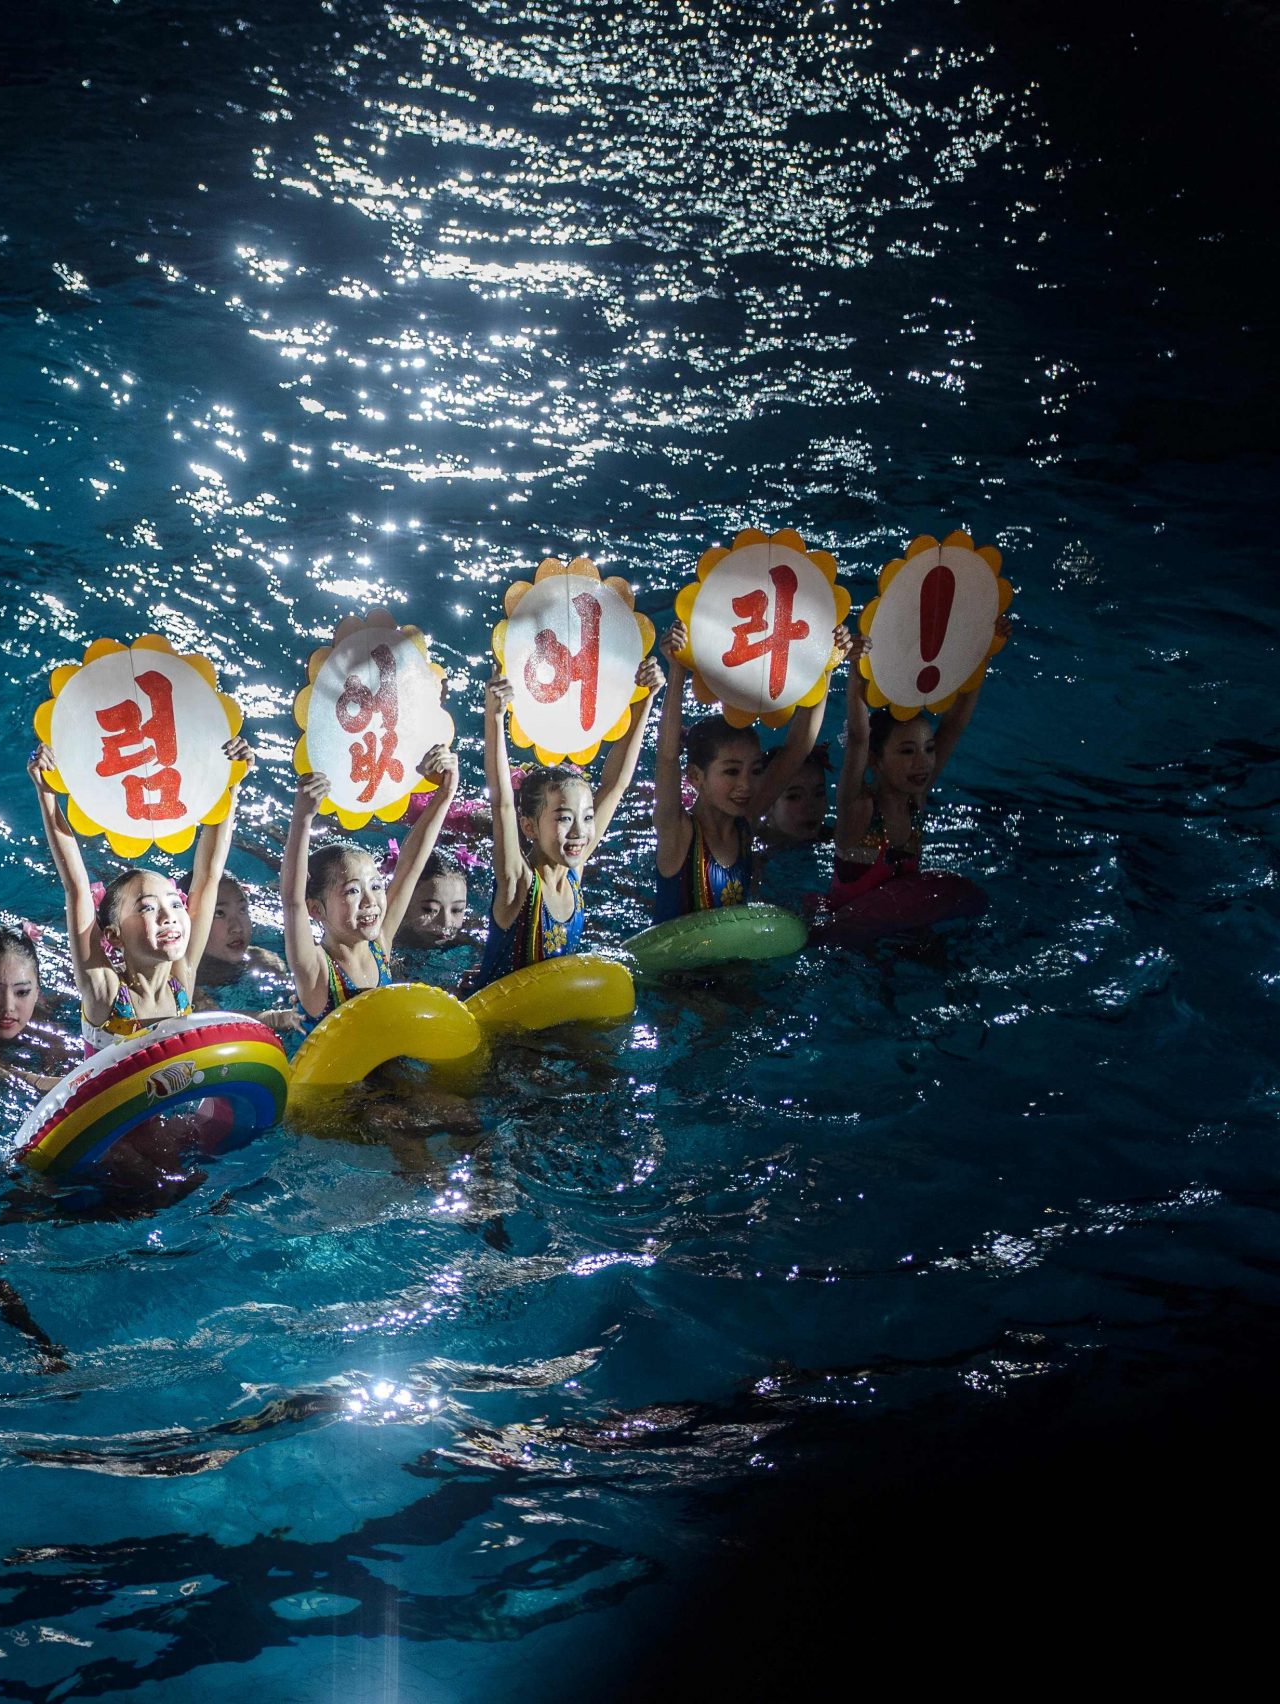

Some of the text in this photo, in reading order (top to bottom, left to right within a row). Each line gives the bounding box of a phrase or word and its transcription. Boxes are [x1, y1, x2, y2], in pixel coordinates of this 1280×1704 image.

[95, 670, 187, 821] 럼
[523, 592, 602, 732] 어
[722, 565, 810, 701] 라
[916, 565, 956, 694] !
